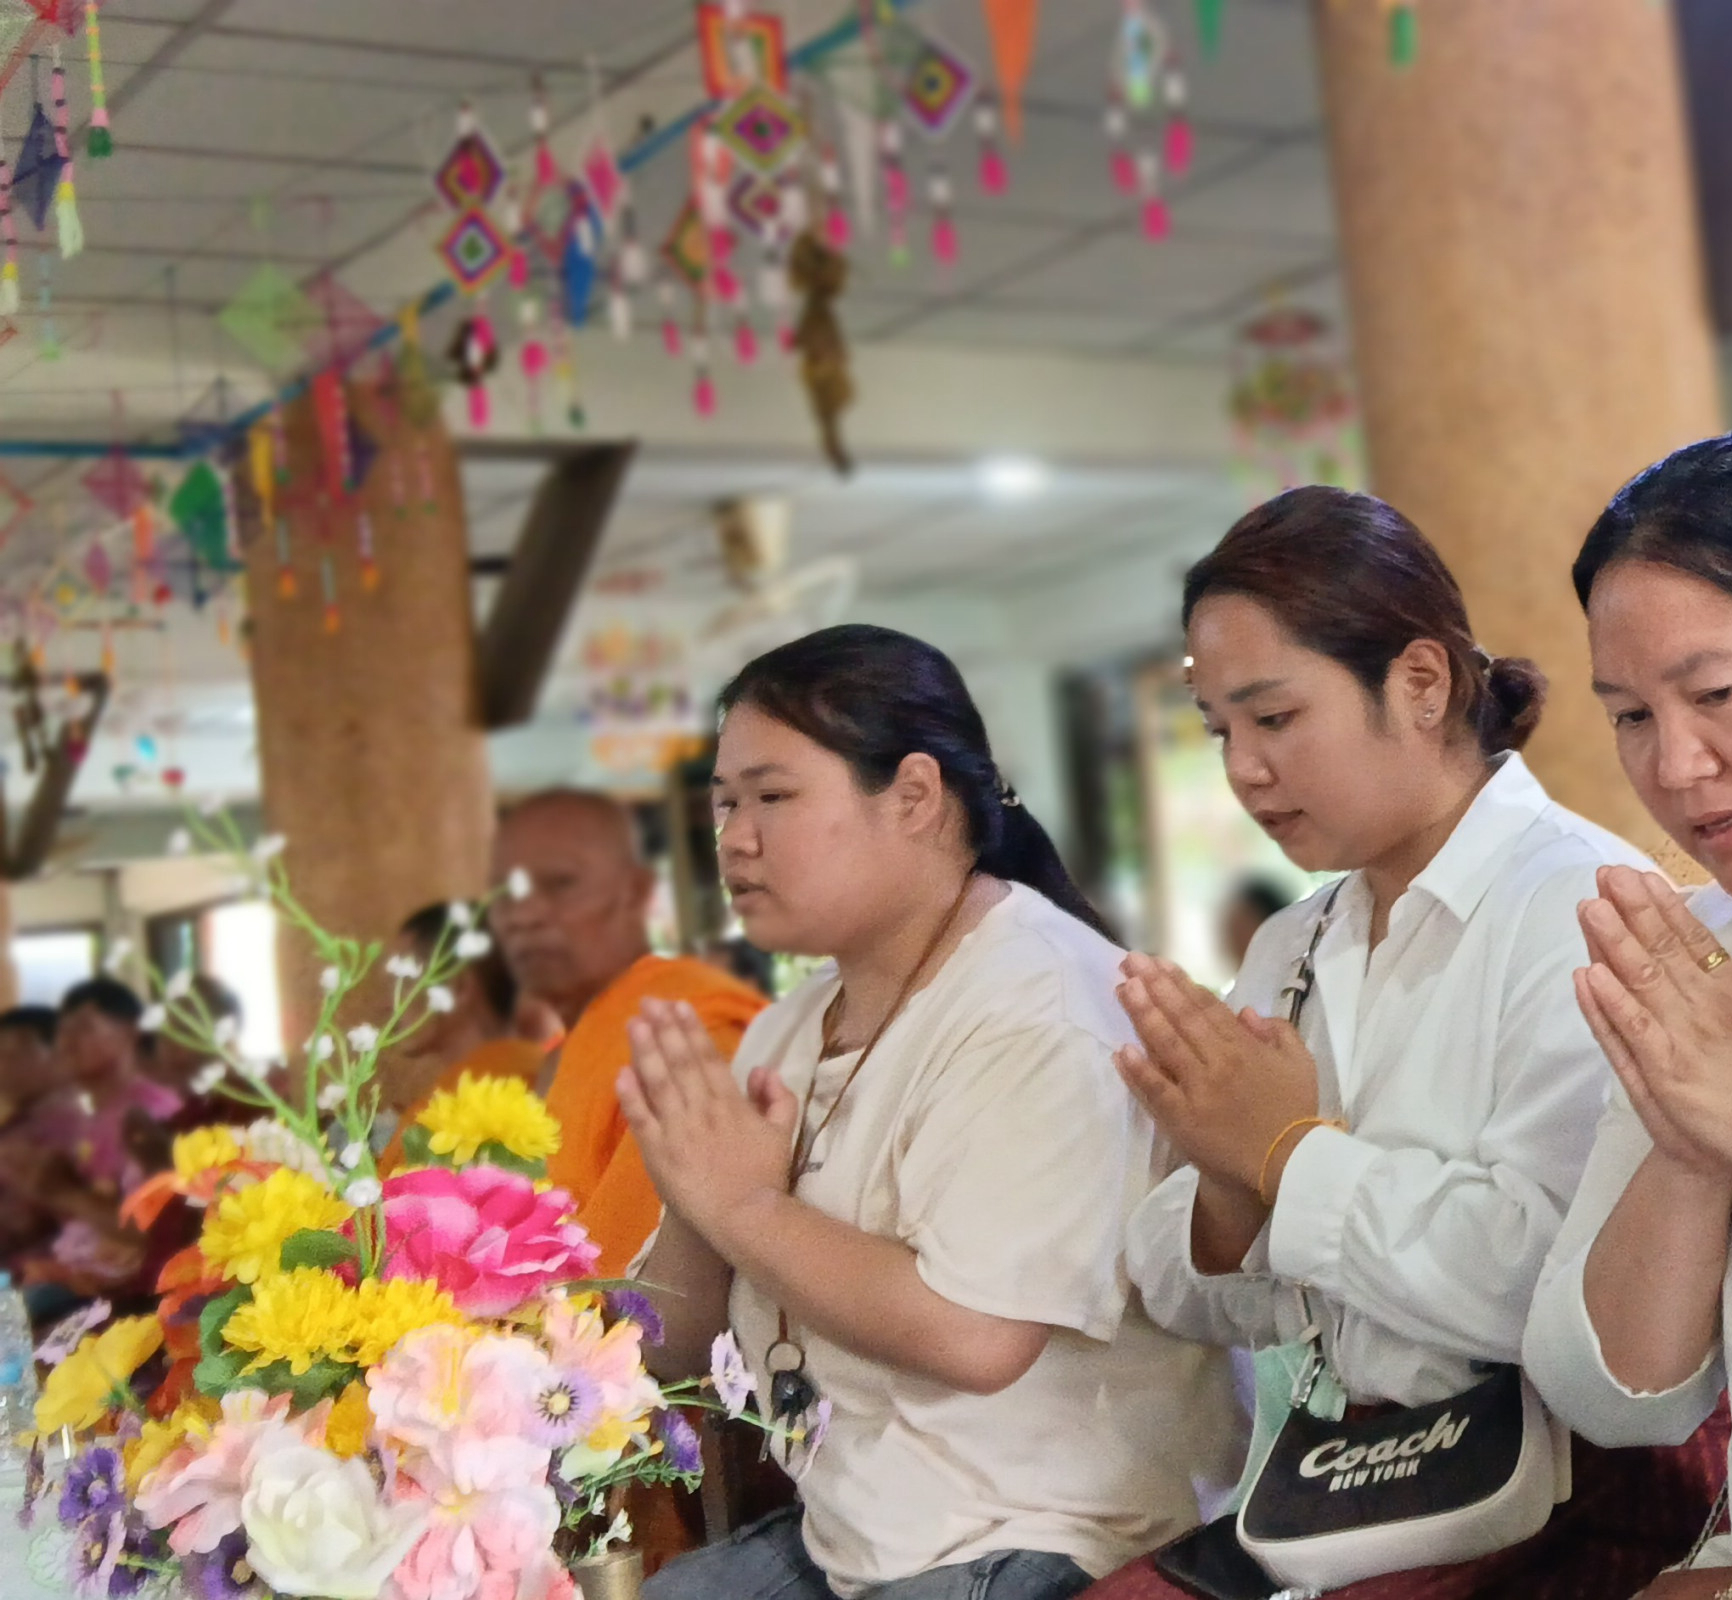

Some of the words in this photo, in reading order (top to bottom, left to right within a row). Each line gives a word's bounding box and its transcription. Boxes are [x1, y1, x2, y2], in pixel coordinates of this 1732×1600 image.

[1299, 1409, 1470, 1478] Coach
[1328, 1468, 1370, 1493] NEW
[1372, 1457, 1421, 1484] YORK
